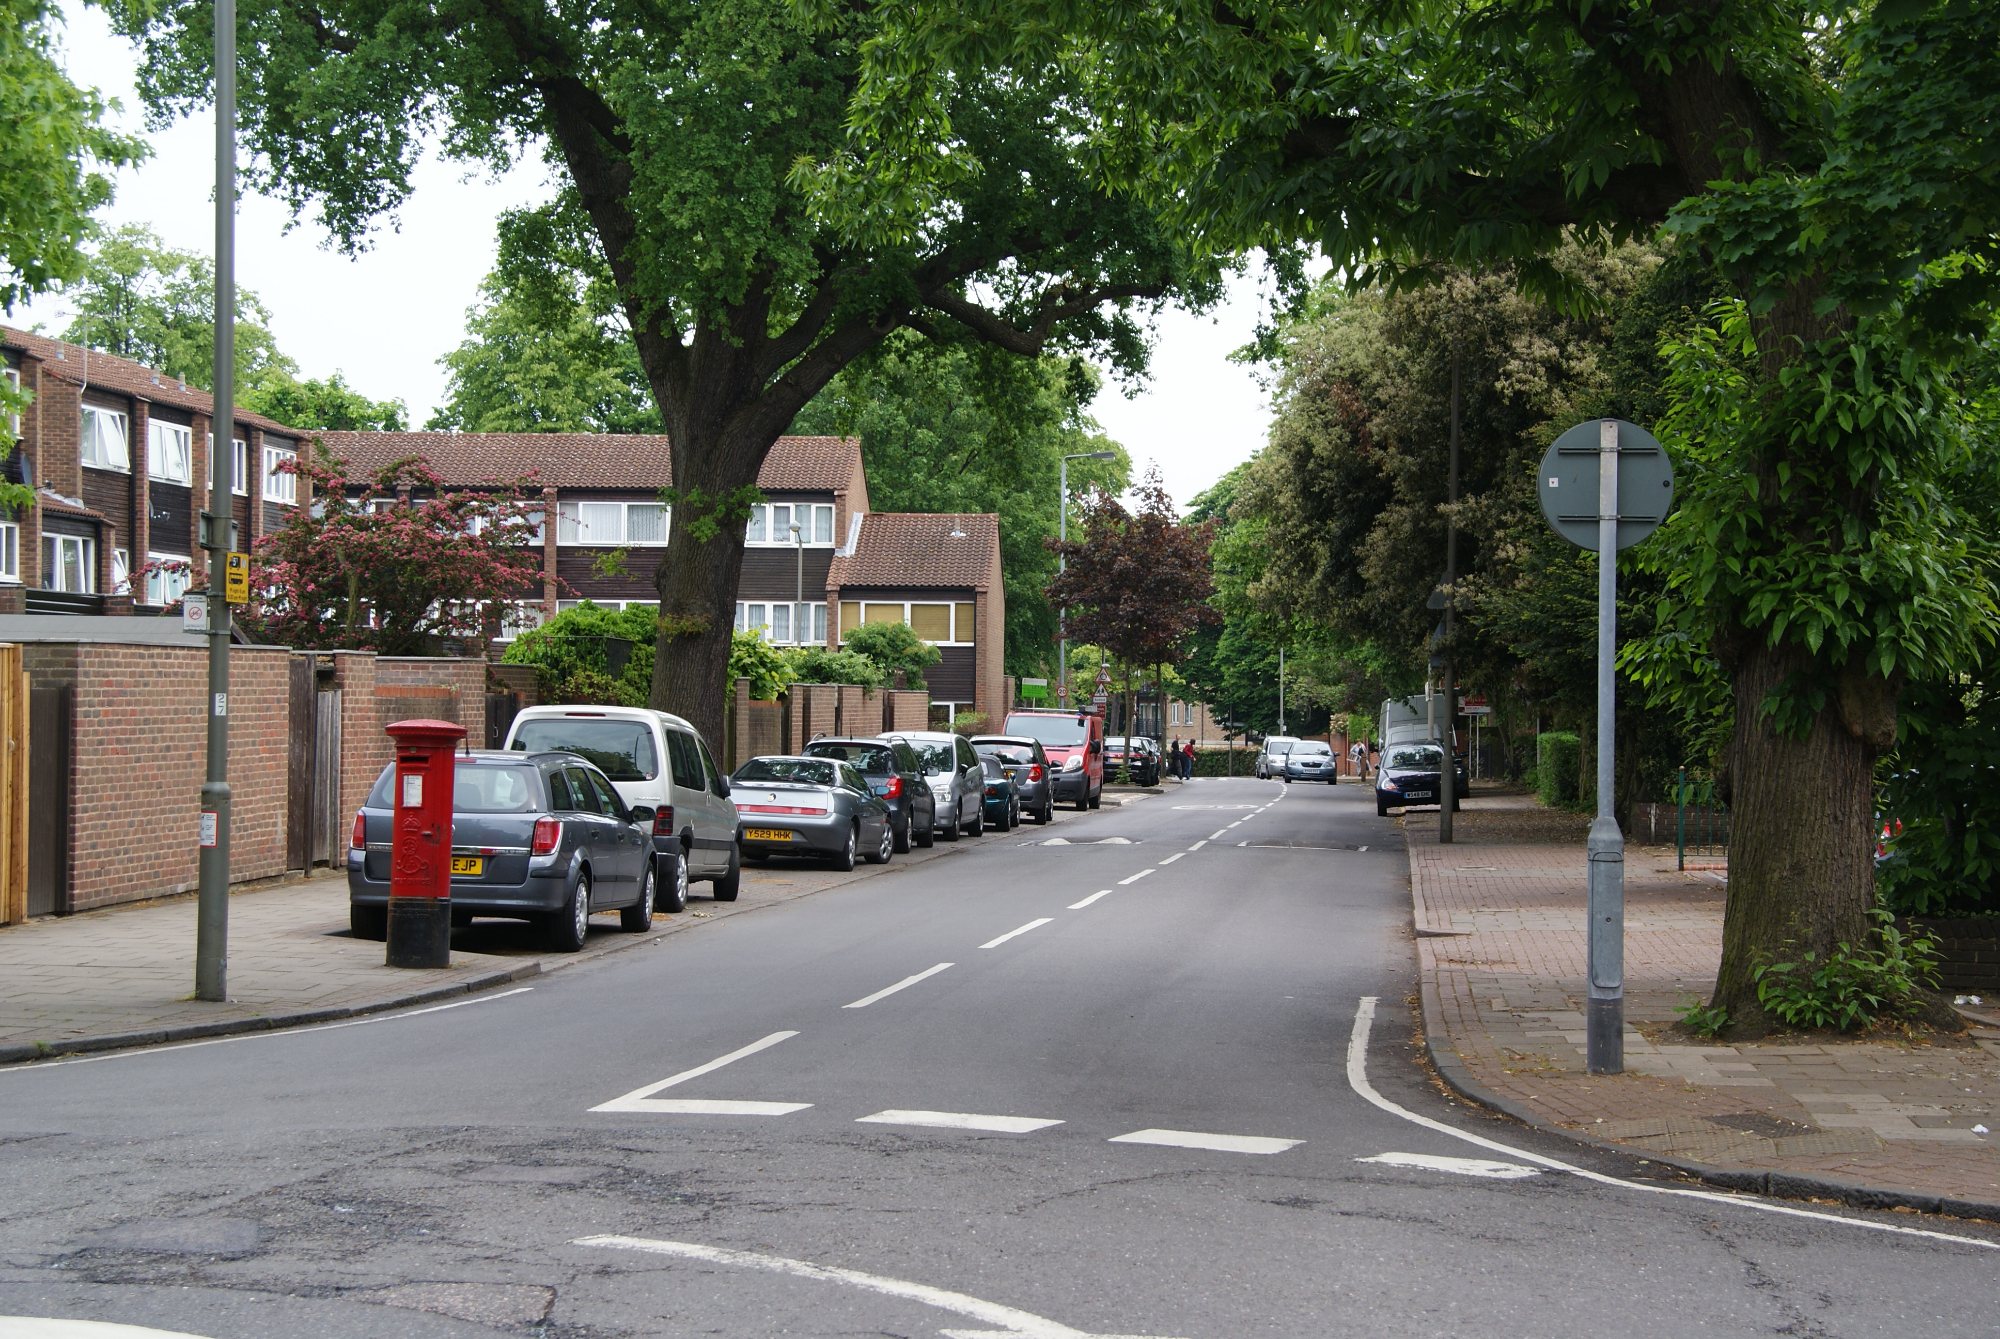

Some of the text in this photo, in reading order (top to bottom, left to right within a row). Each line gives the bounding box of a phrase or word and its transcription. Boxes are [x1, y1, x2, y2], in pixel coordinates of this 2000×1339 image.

[748, 830, 791, 840] Y529 HHK
[452, 859, 477, 871] EJP
